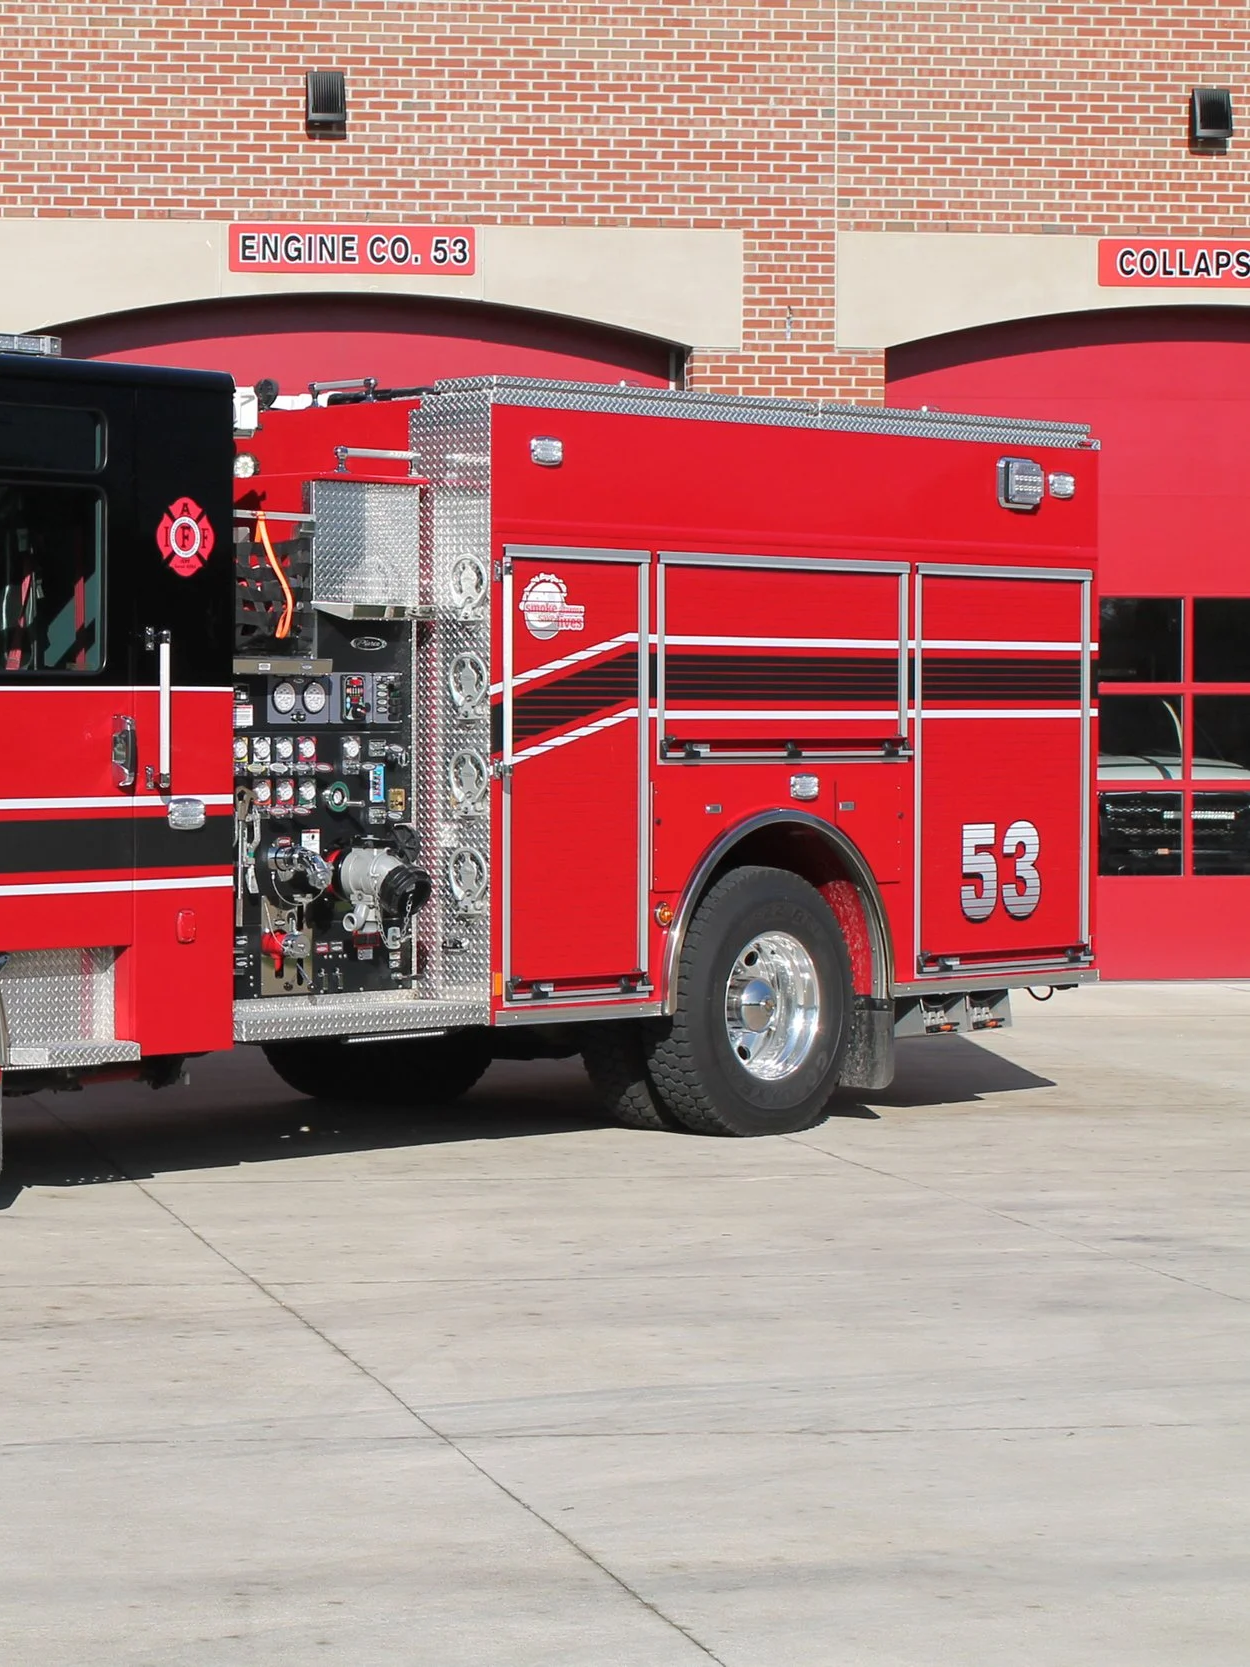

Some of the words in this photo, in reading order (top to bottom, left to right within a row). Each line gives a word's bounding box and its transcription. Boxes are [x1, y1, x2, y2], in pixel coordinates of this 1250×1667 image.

[239, 233, 359, 264] ENGINE
[367, 235, 421, 265] CO.
[431, 237, 470, 265] 53
[525, 602, 557, 612] smoke
[960, 819, 1041, 923] 53
